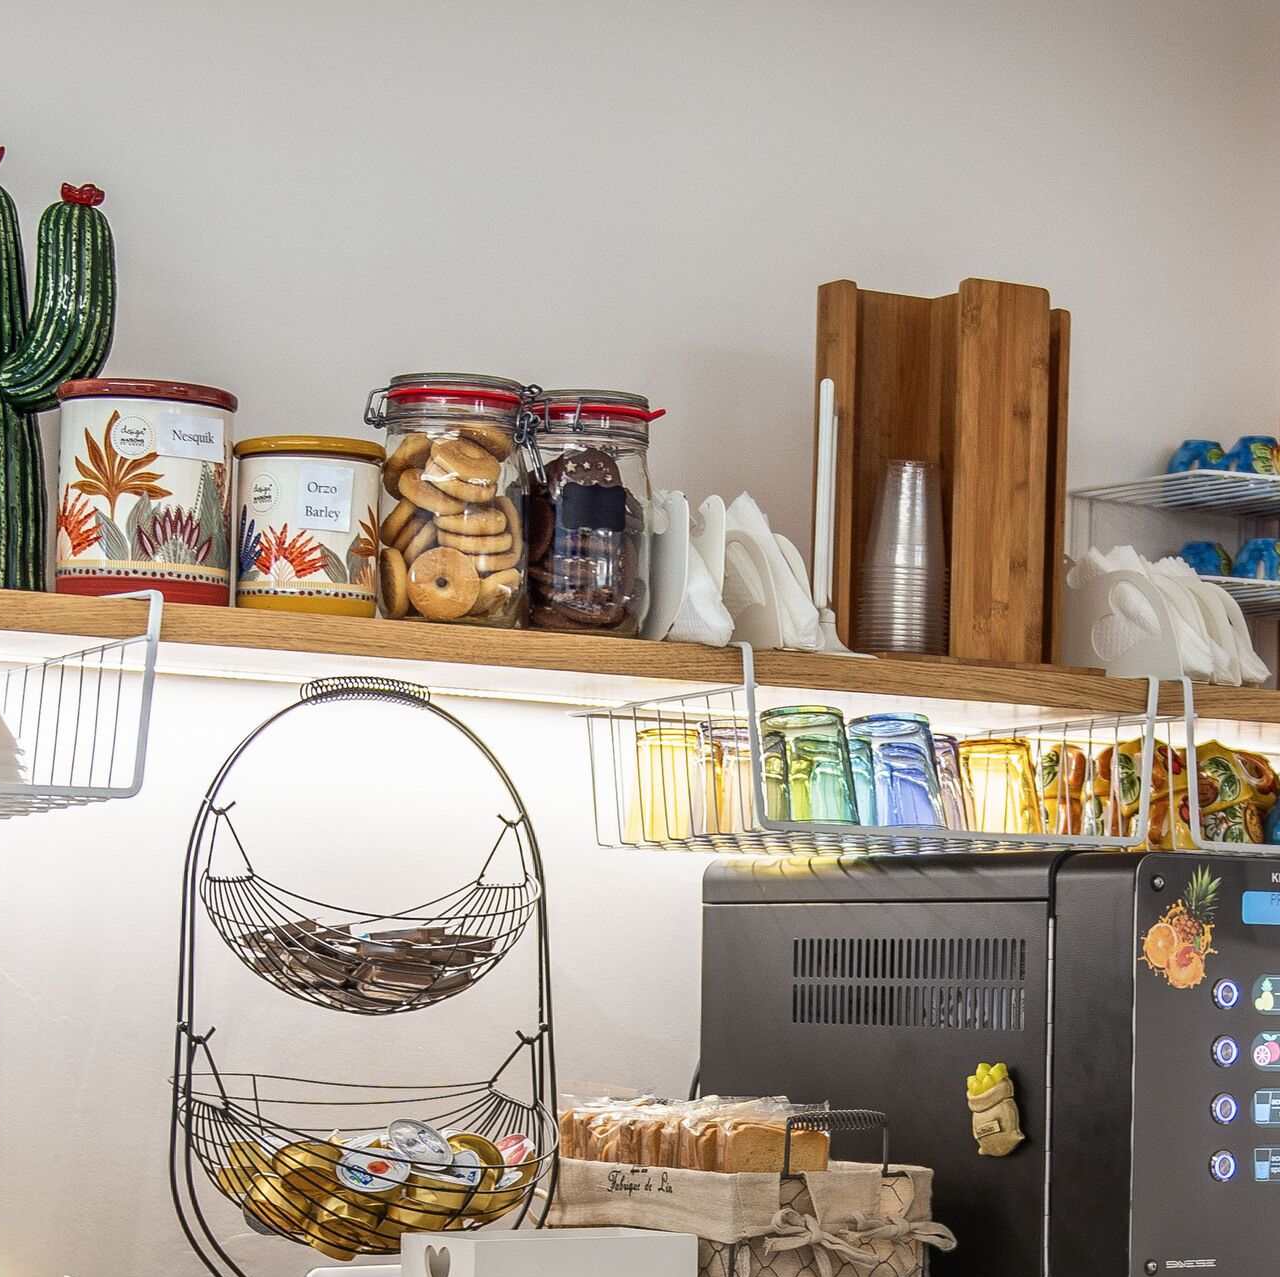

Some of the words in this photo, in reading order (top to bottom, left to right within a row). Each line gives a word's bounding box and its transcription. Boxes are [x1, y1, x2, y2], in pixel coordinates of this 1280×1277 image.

[172, 429, 215, 446] Nesquik
[307, 481, 338, 495] Orzo
[304, 505, 341, 522] Barley
[608, 1170, 641, 1197] Fabrique
[644, 1177, 652, 1192] de
[658, 1171, 673, 1193] Lin
